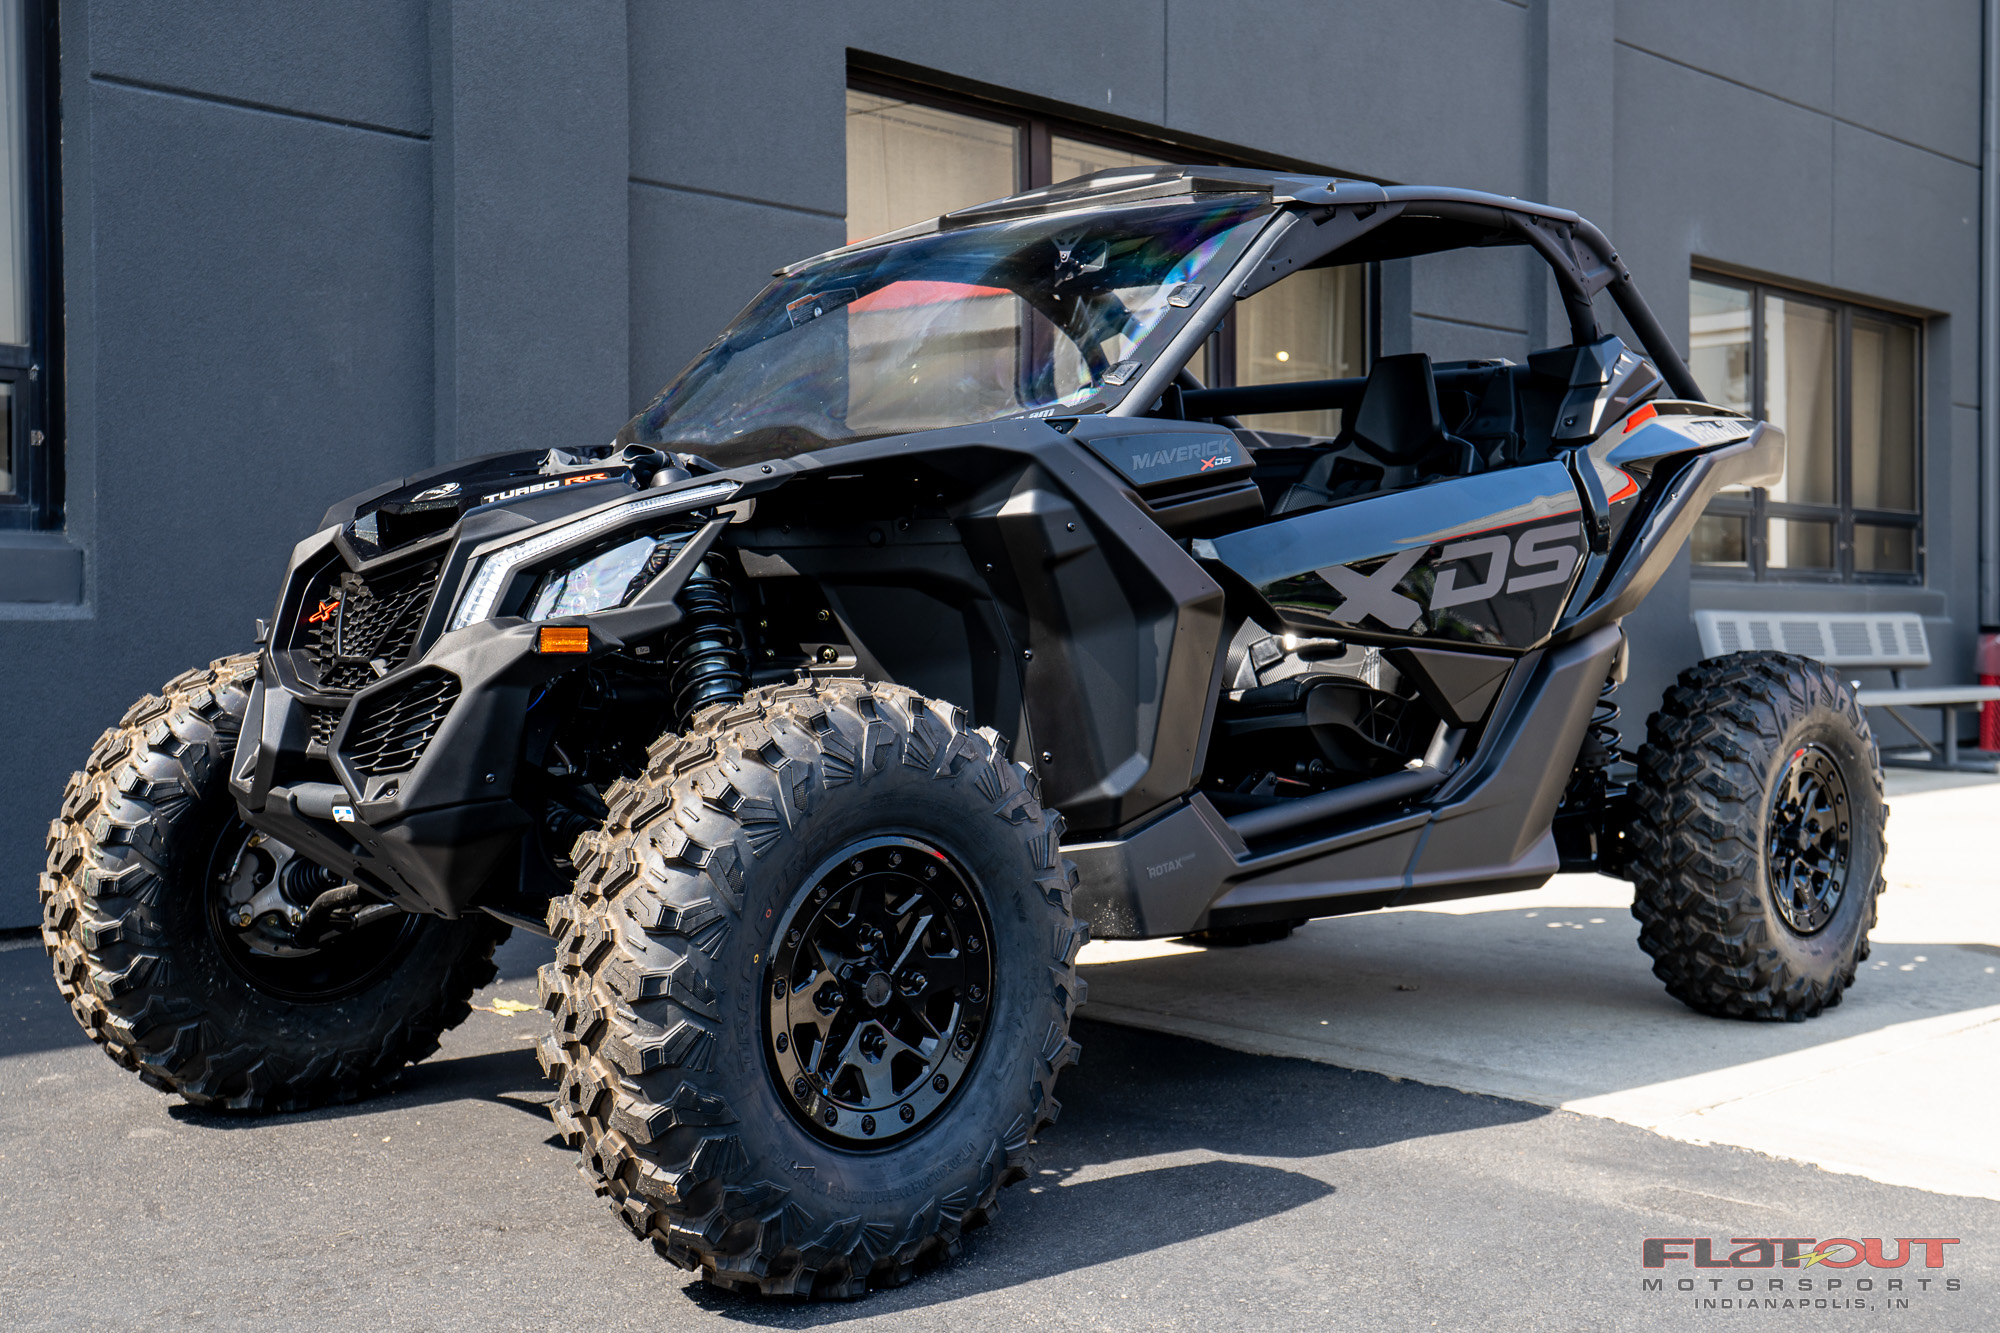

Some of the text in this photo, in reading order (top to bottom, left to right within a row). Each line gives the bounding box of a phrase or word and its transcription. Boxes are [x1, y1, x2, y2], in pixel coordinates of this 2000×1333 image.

[1131, 439, 1231, 470] MAVERICK
[1200, 456, 1232, 472] XDS
[484, 472, 608, 503] TURBO RR
[1315, 521, 1580, 630] XDS
[1148, 857, 1183, 879] ROTAX
